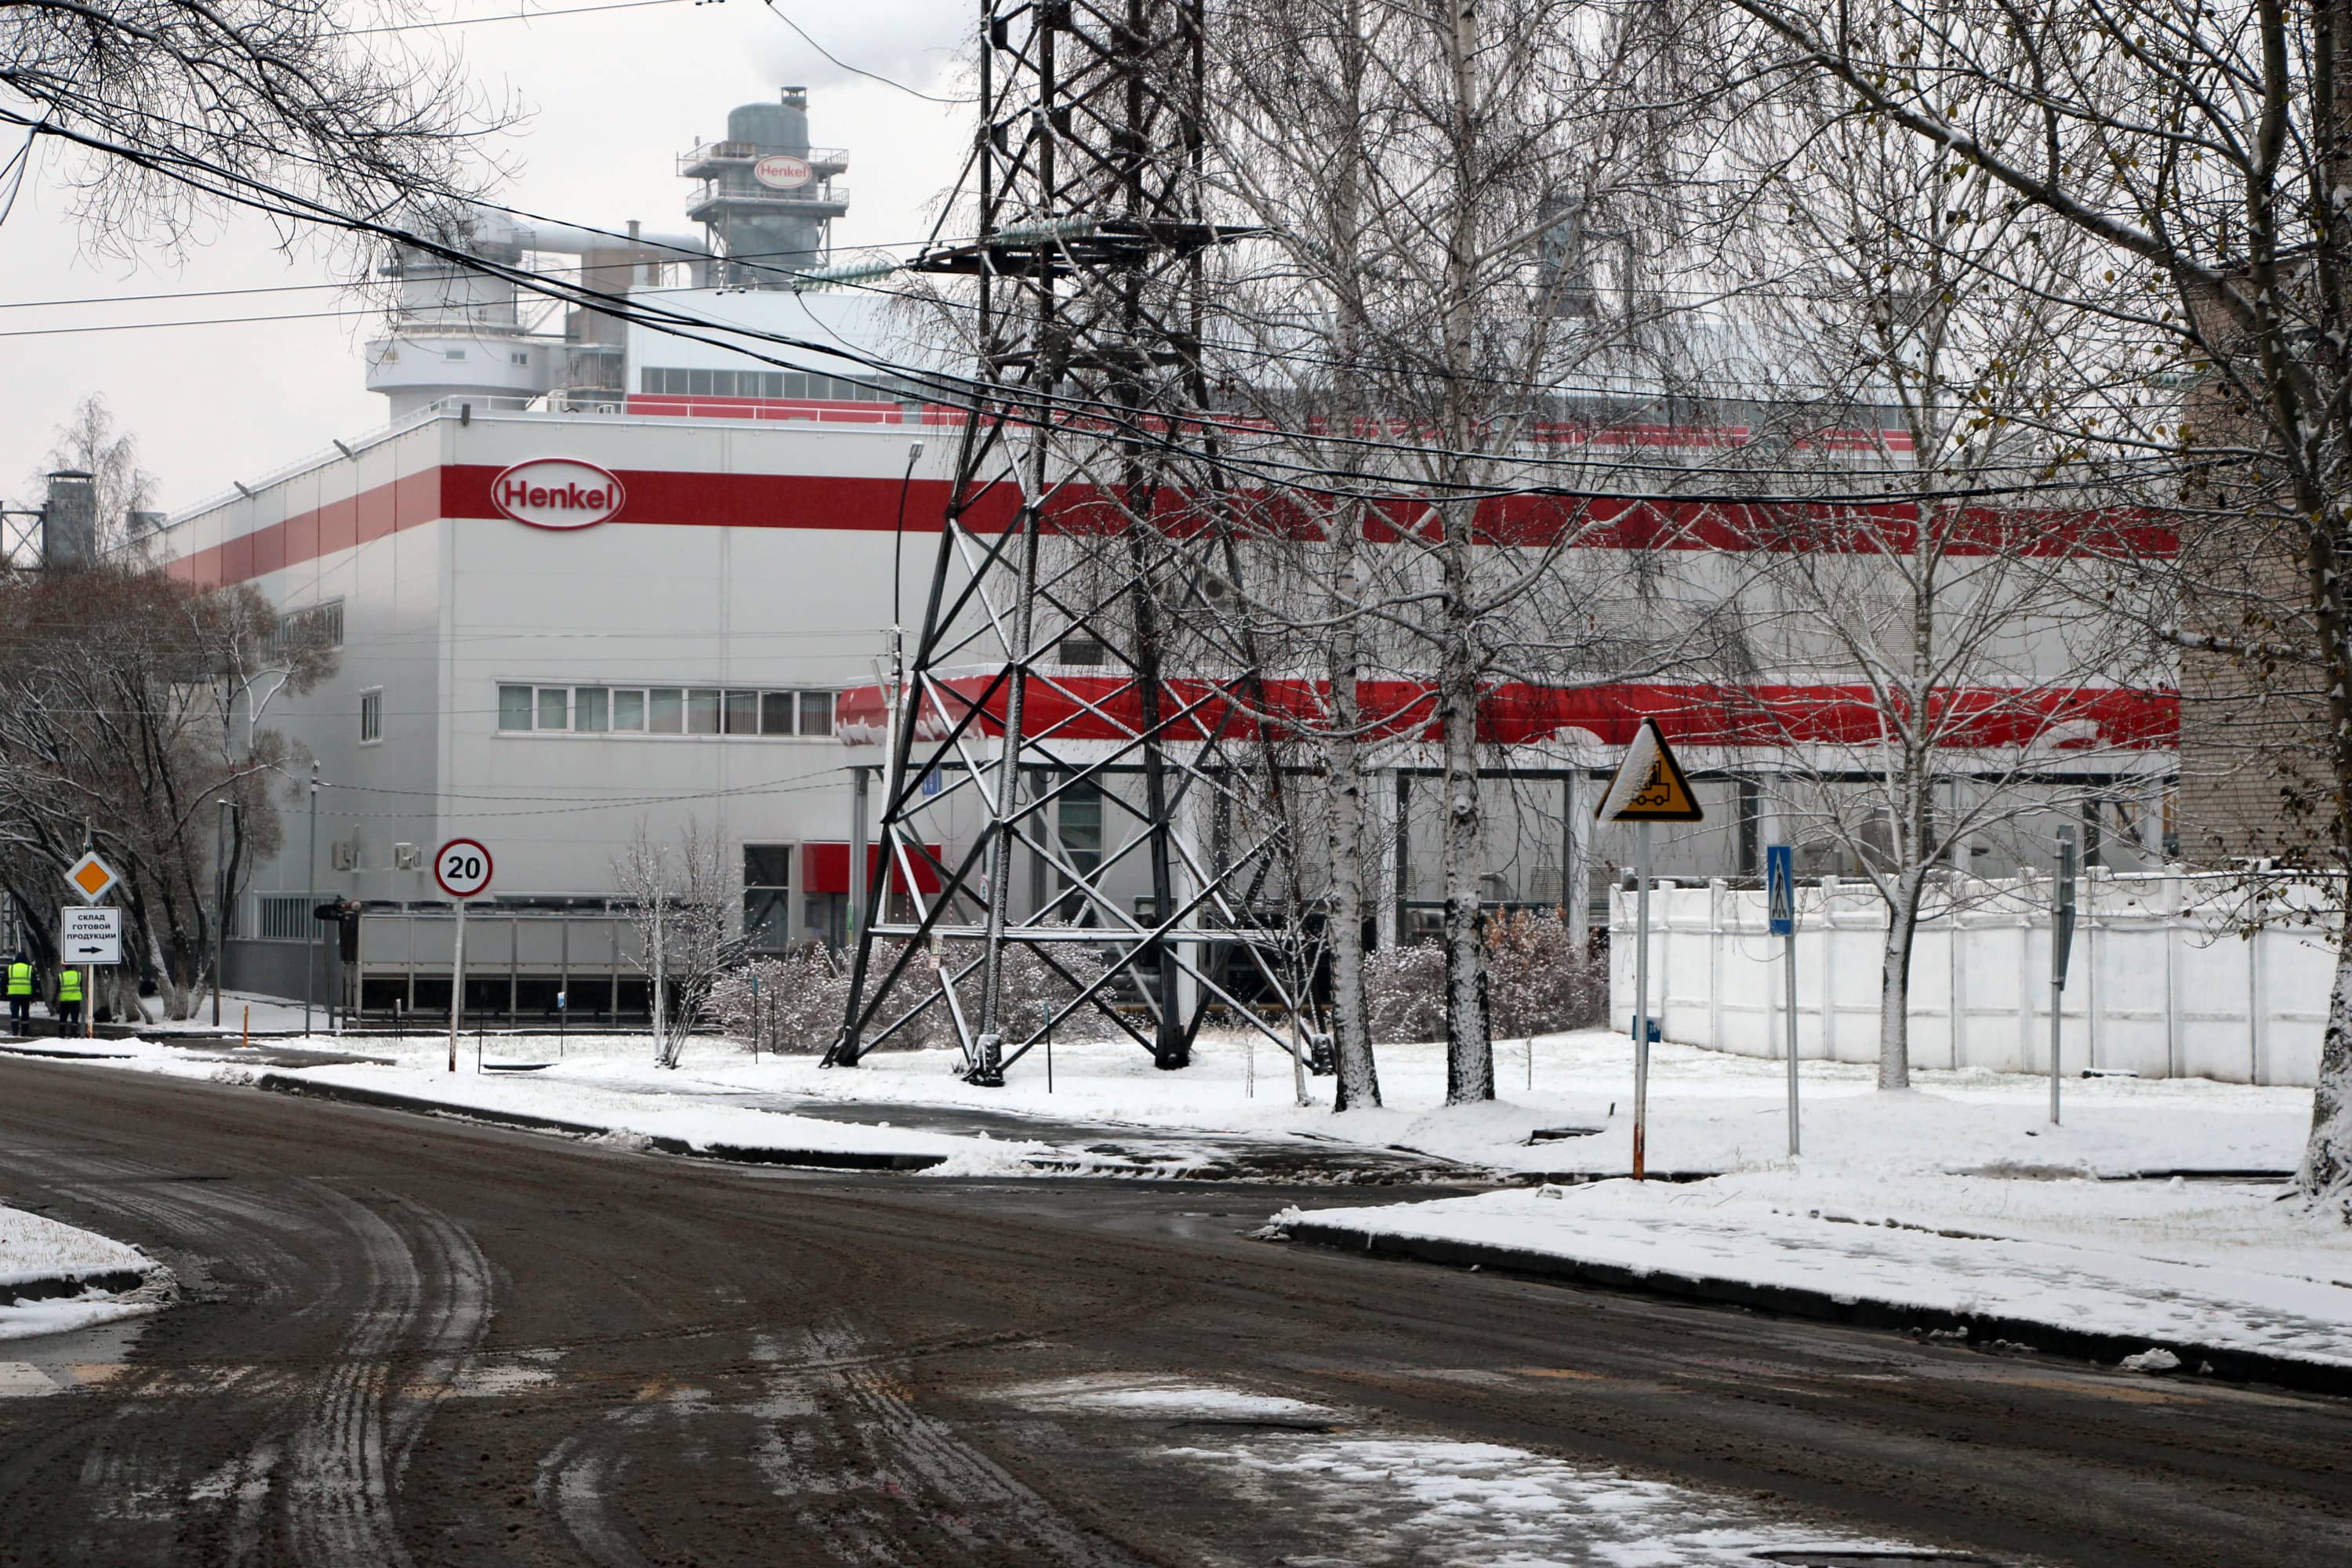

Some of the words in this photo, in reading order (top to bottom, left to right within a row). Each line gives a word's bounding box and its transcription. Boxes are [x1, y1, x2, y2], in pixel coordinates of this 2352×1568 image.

[760, 164, 806, 177] Henkel
[504, 480, 614, 510] Henkel
[447, 856, 481, 880] 20
